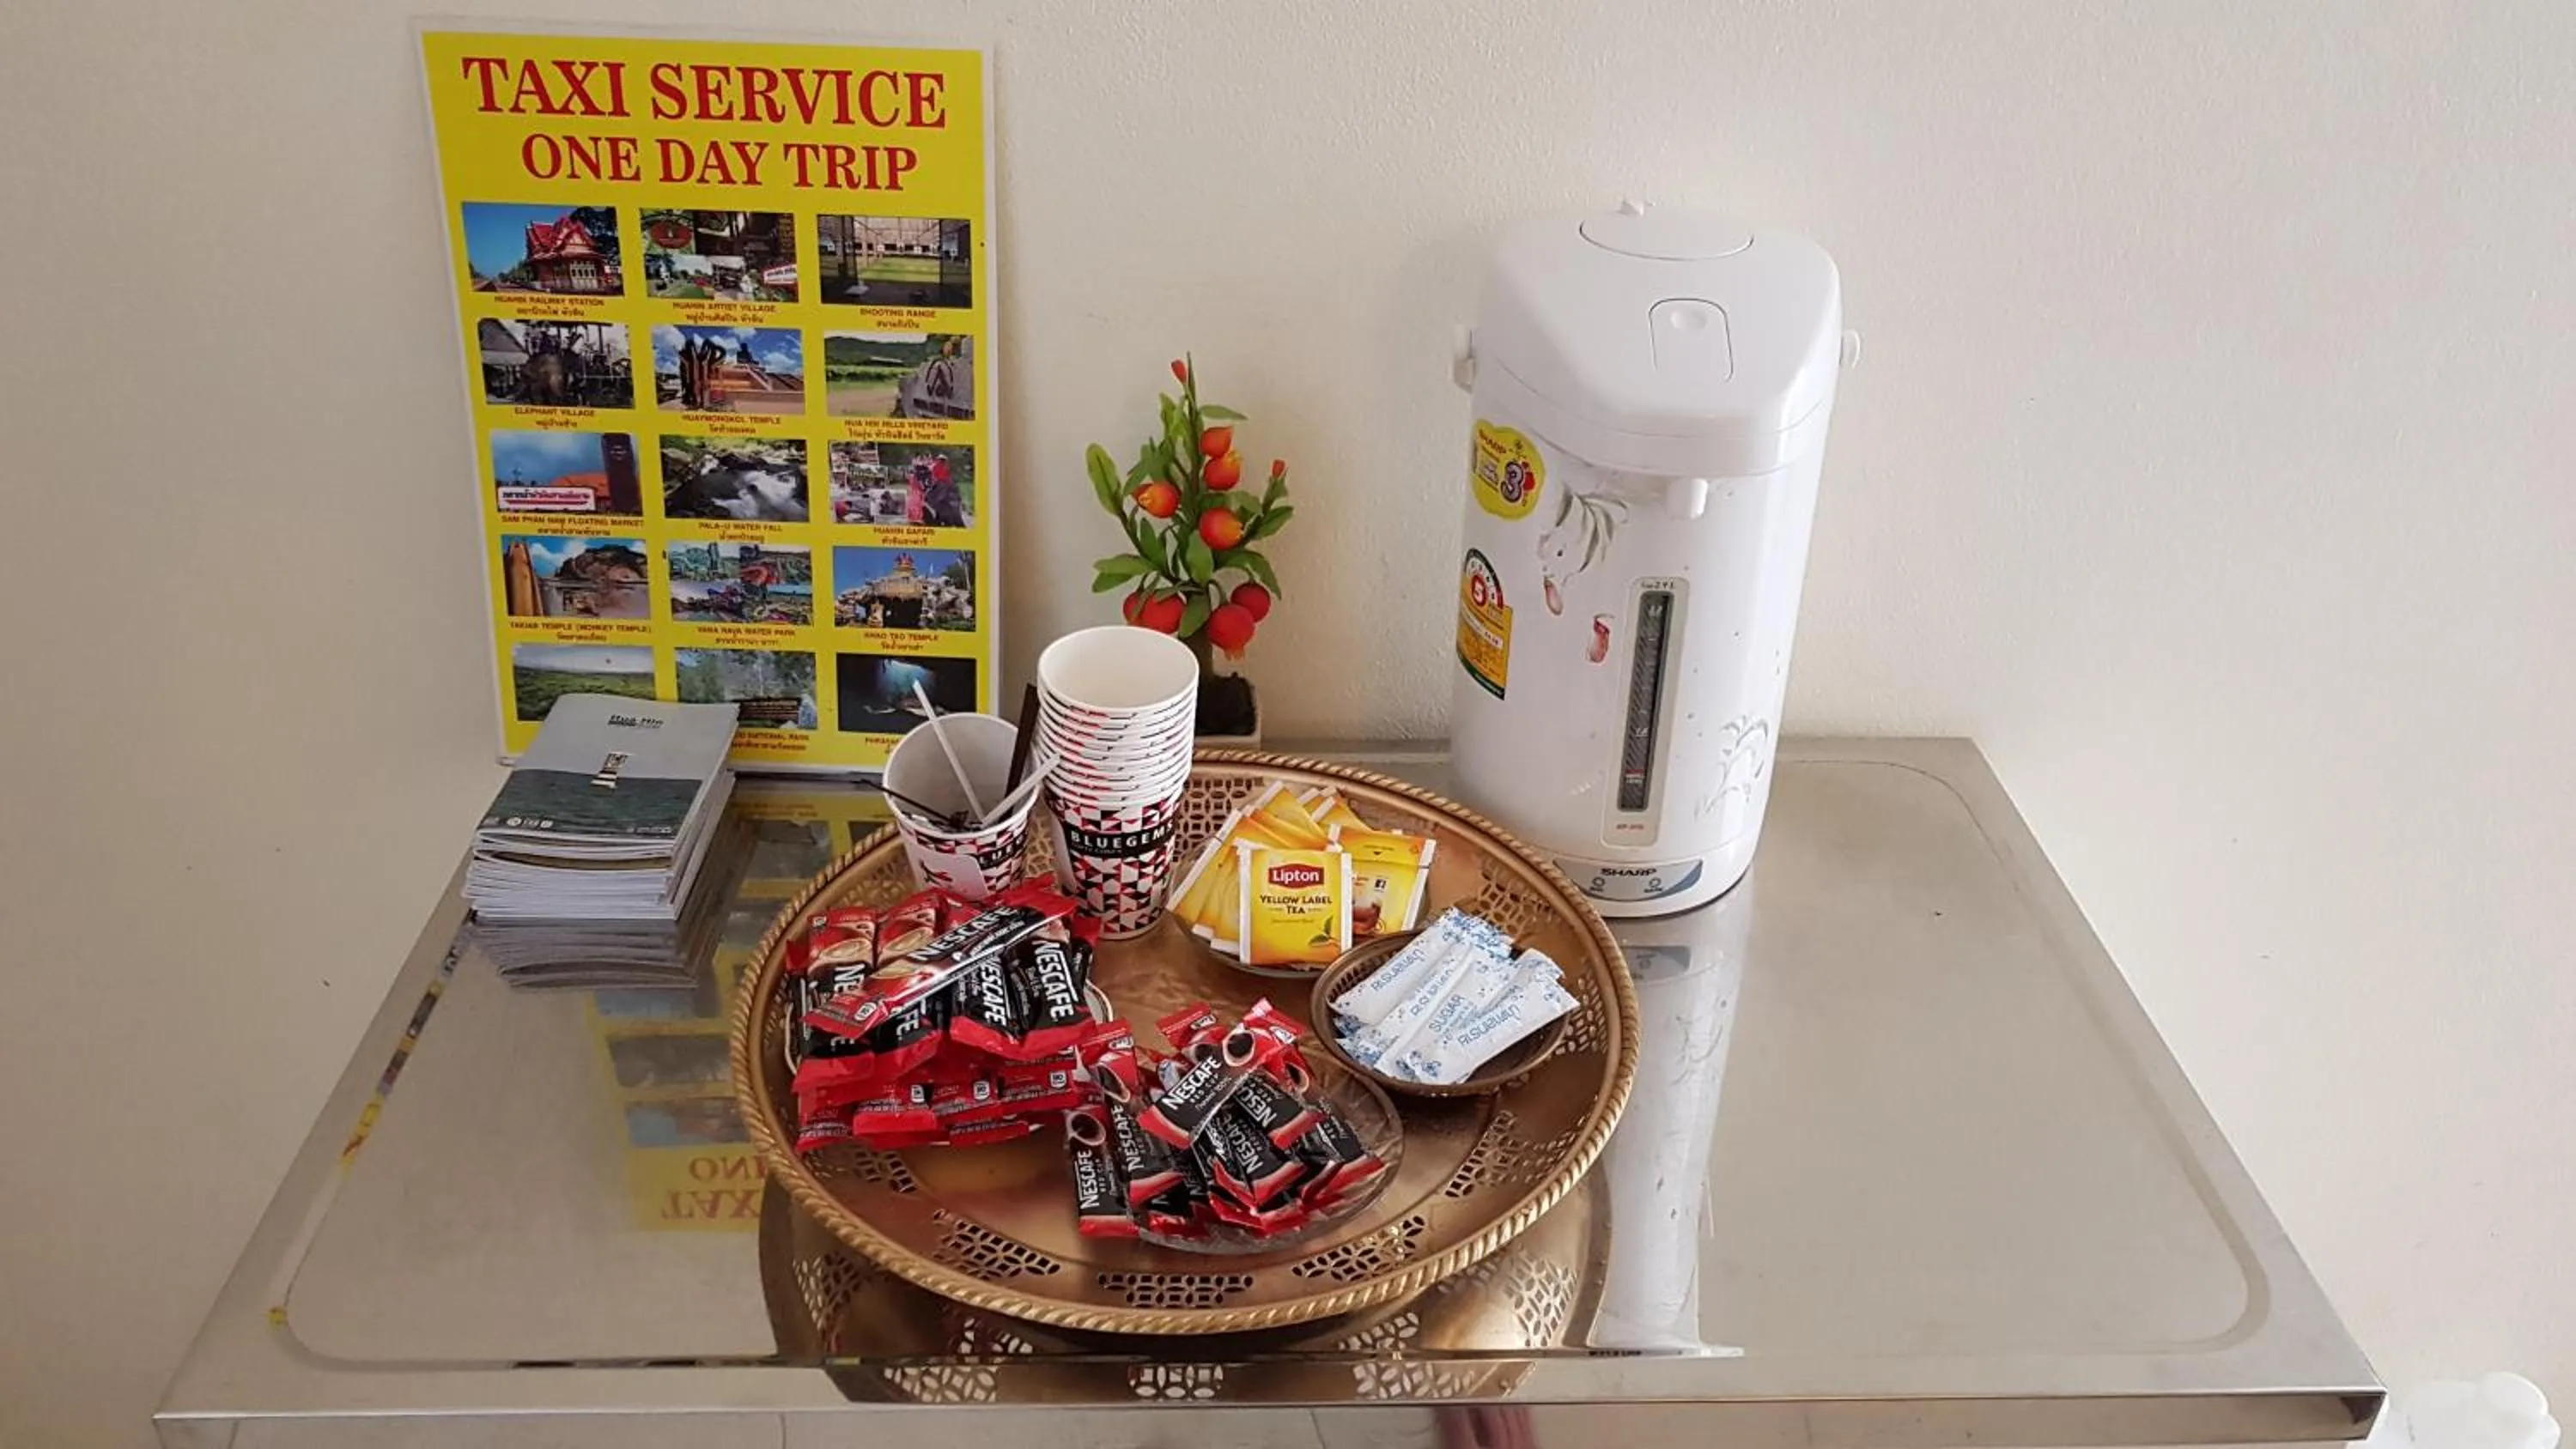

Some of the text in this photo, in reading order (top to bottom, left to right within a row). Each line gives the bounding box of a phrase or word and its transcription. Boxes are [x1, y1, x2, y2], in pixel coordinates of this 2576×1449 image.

[461, 56, 946, 129] TAXI SERVICE
[521, 133, 918, 191] ONE DAY TRIP
[708, 302, 737, 311] ARTIST
[740, 304, 776, 312] VILLAGE
[907, 309, 936, 318] RANGE
[560, 408, 594, 416] VILLAGE
[568, 517, 608, 525] FLOATING
[611, 518, 644, 527] MARKET
[1273, 869, 1320, 885] Lipton
[1601, 868, 1657, 876] SHARP
[1260, 895, 1299, 904] YELLOW
[1286, 906, 1306, 914] TEA
[906, 906, 1018, 961] NESCAFE
[1031, 940, 1075, 1022] NESCAFE
[1428, 993, 1465, 1033] SUGAR
[1161, 1056, 1222, 1111] NESCAFE
[1238, 1085, 1279, 1126] NESC
[1110, 1104, 1145, 1173] NESCAFE
[1077, 1149, 1100, 1210] NESCAFE
